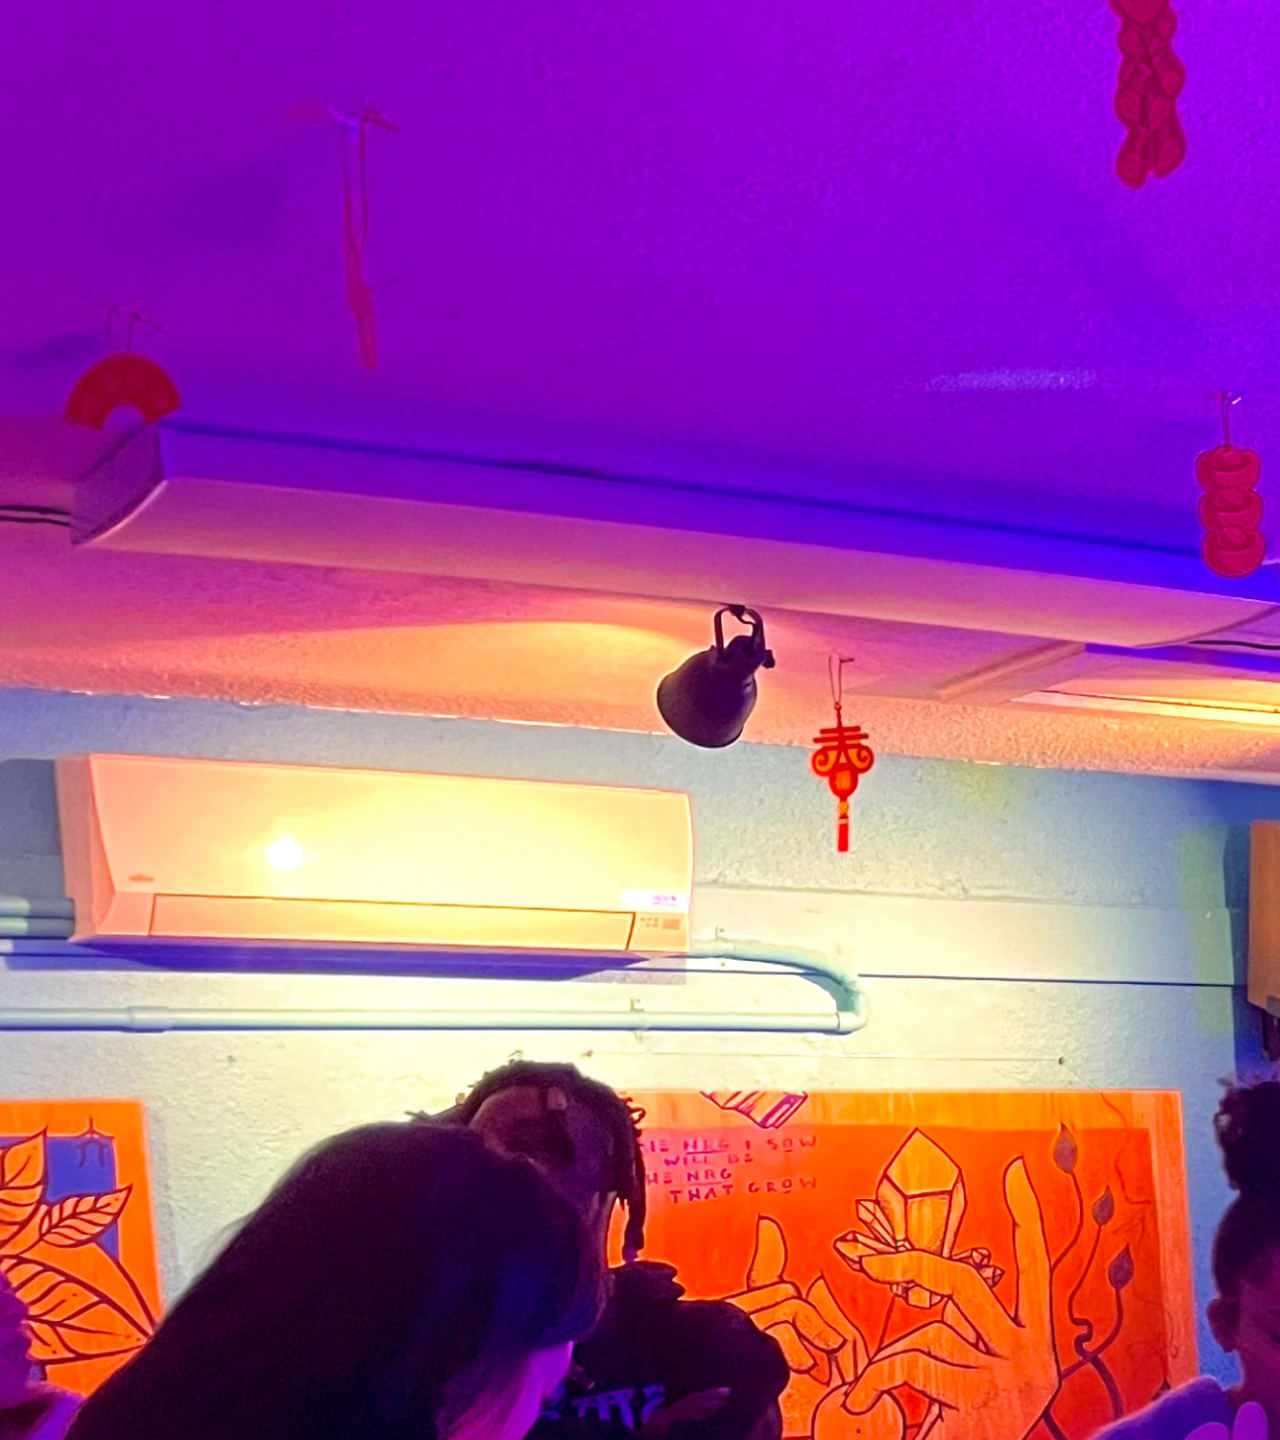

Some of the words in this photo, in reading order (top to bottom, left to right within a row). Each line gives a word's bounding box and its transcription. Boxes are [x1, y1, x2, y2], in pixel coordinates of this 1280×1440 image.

[767, 1136, 816, 1152] SOW
[664, 1155, 710, 1166] WILL
[727, 1154, 753, 1163] BE
[687, 1169, 732, 1184] NRG
[670, 1185, 733, 1204] THAT
[748, 1178, 817, 1194] GROW
